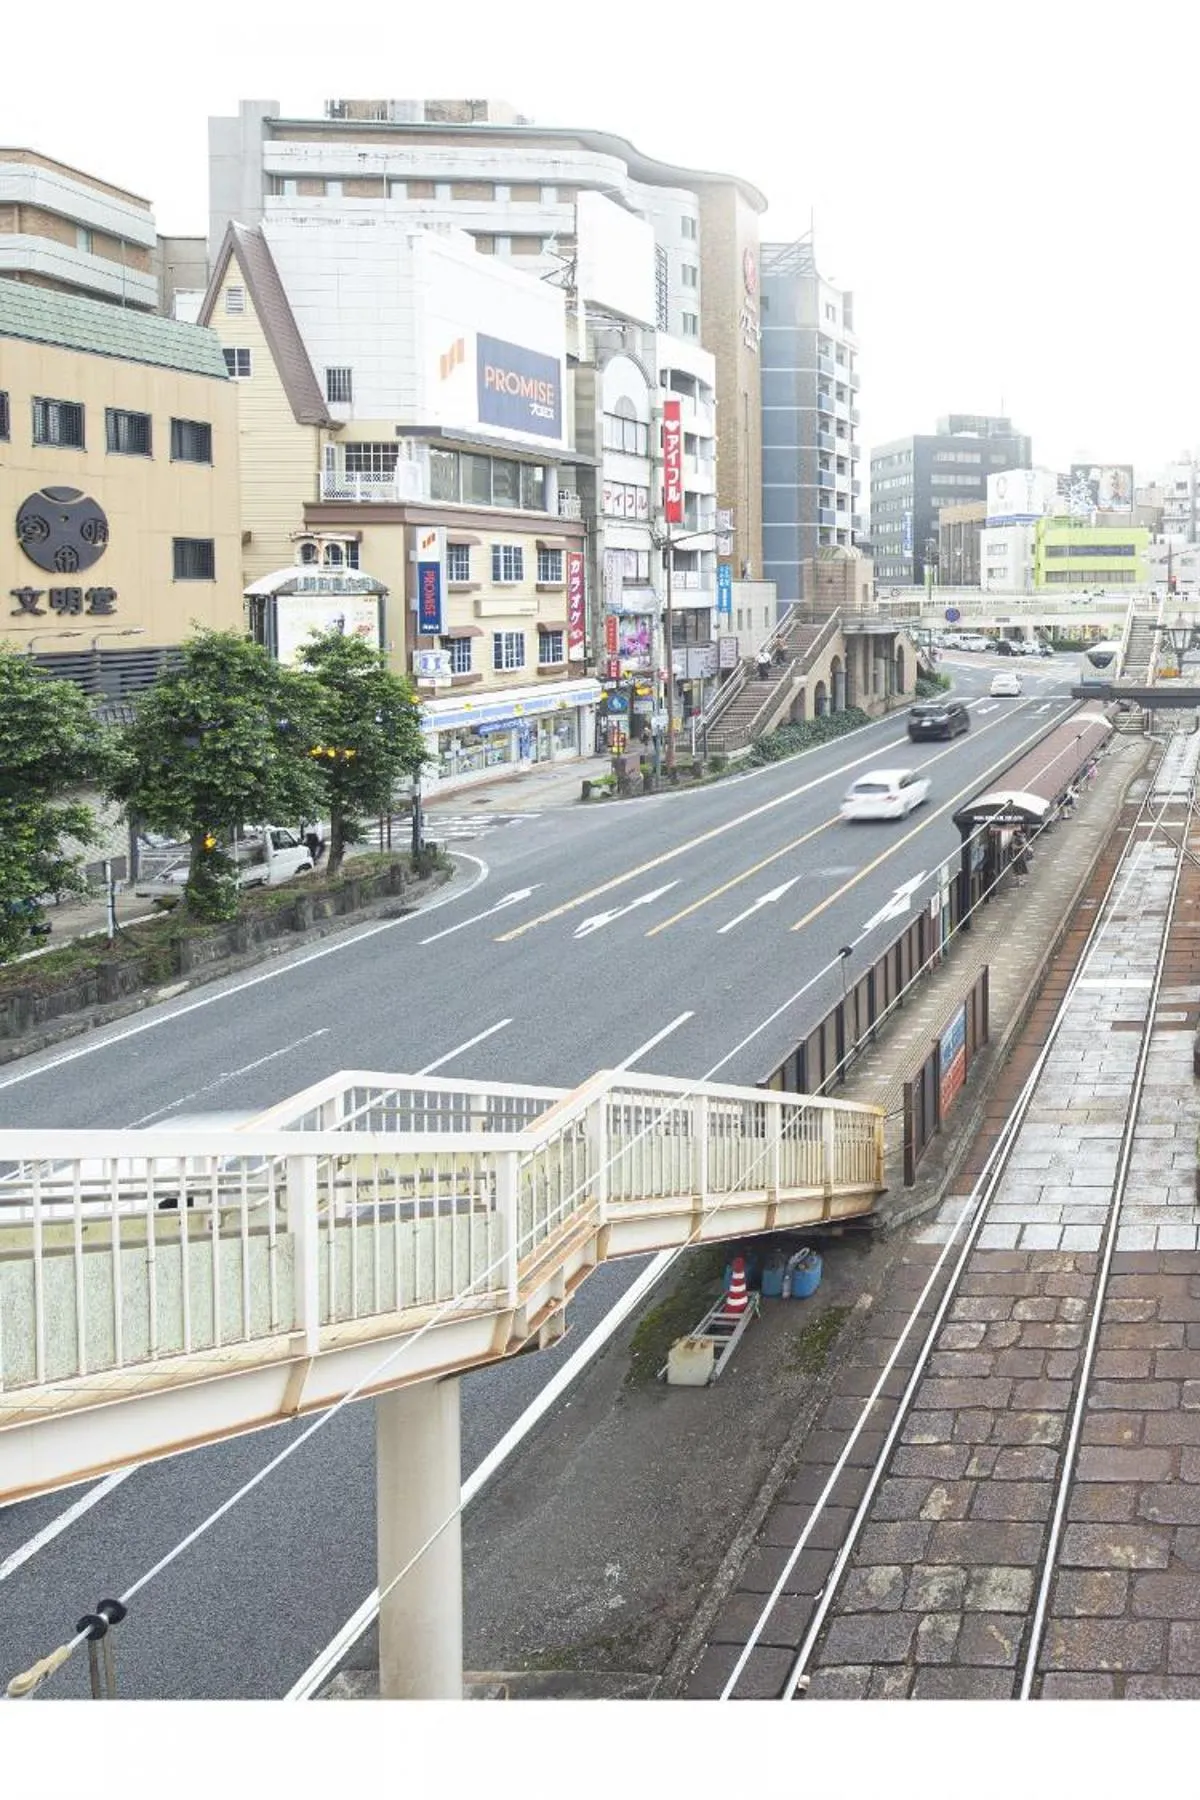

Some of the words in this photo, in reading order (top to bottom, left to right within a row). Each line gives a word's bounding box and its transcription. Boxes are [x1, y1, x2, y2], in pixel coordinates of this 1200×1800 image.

[484, 365, 555, 406] PROMISE
[666, 434, 680, 503] アイフル
[603, 489, 648, 511] アイフル
[9, 586, 118, 616] 文明堂
[423, 569, 437, 617] PROMISE
[570, 559, 583, 627] カラオケ
